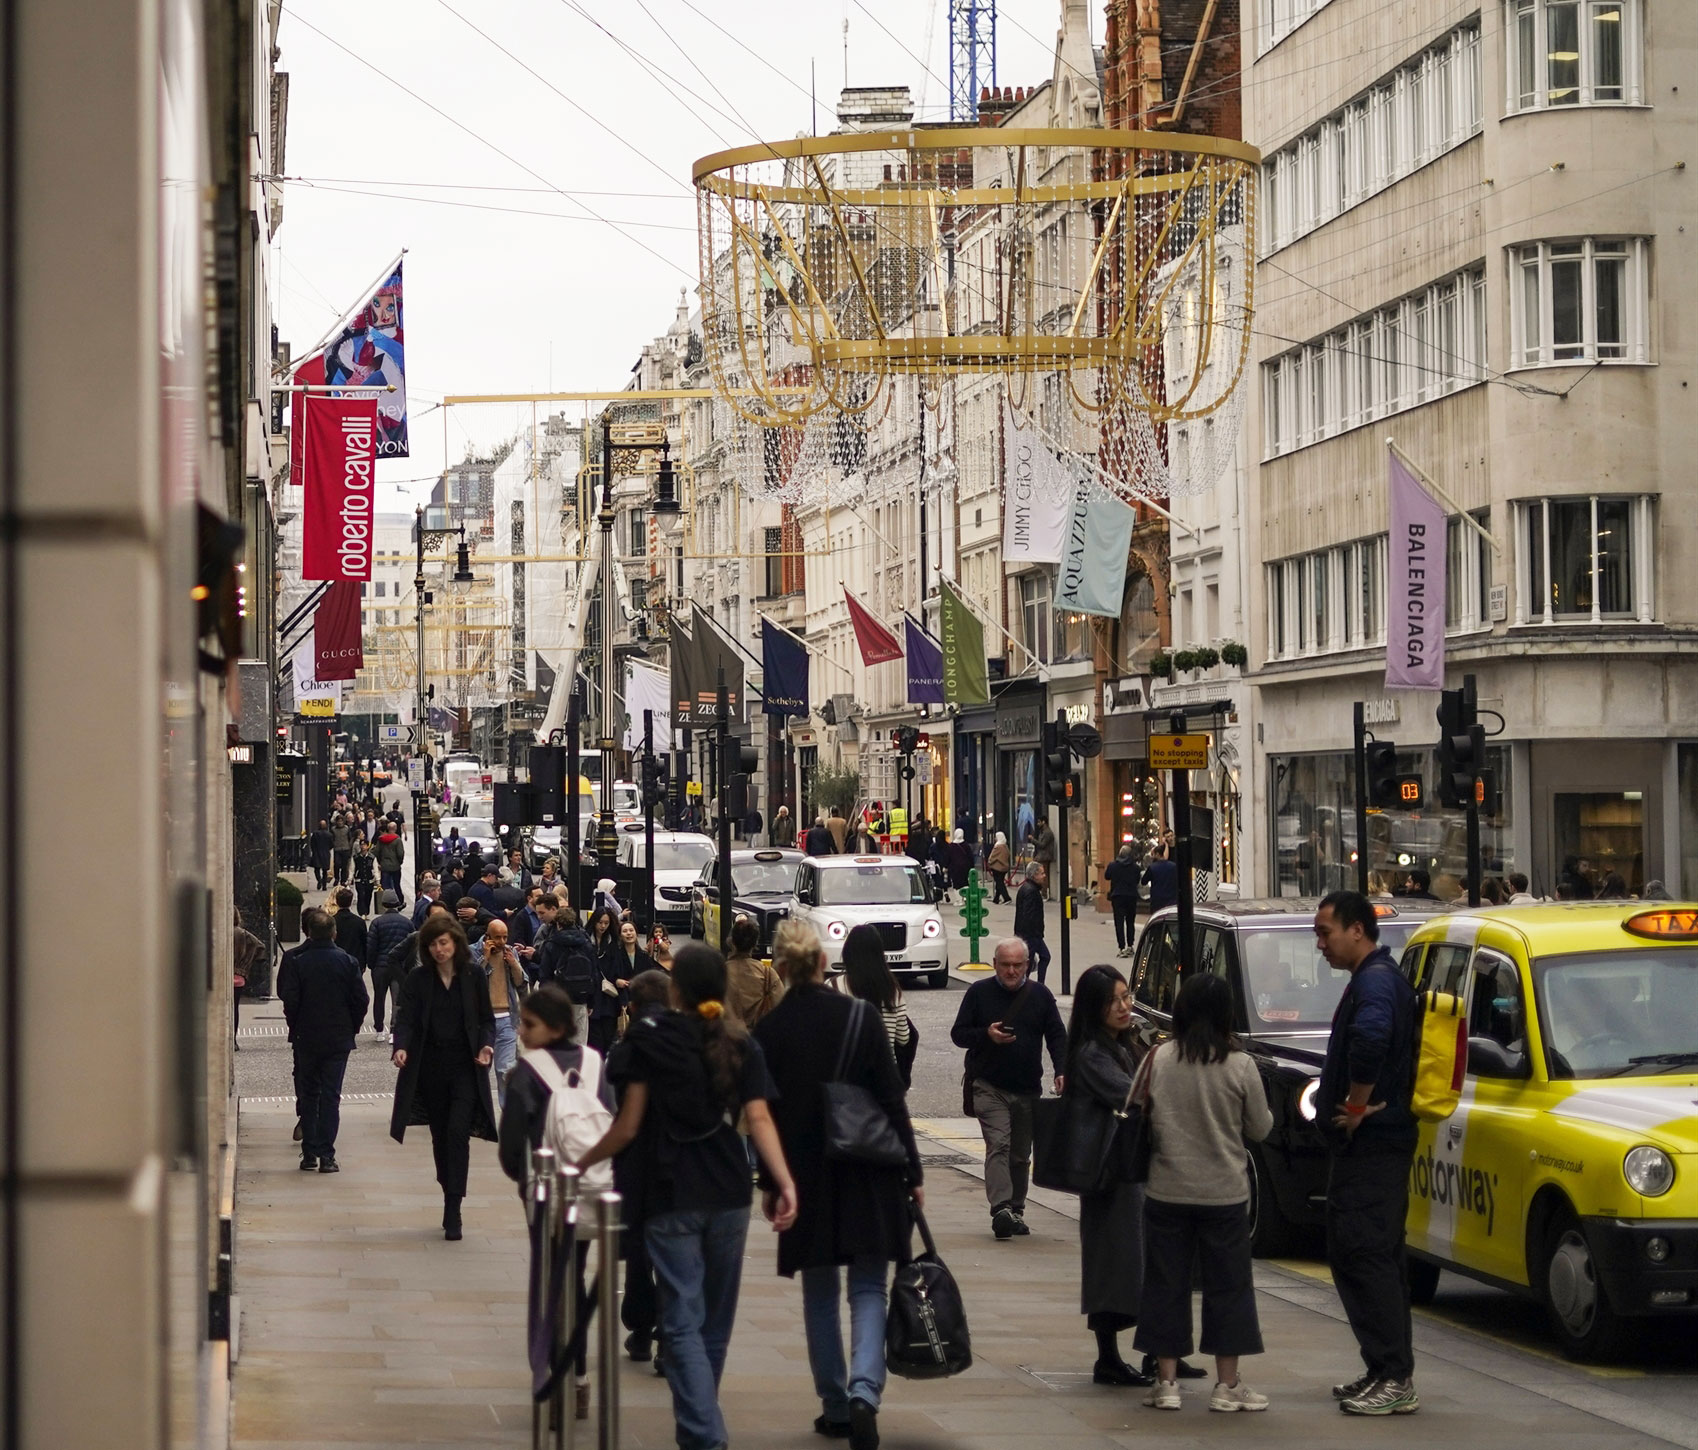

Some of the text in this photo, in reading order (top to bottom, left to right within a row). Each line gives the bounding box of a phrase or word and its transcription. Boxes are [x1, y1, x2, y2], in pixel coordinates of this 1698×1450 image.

[337, 416, 372, 577] roberto cavalli
[1014, 504, 1030, 551] JIMMY
[1406, 523, 1426, 669] BALENCIAGA
[321, 648, 360, 659] GUCCI
[944, 598, 957, 697] LONGCHAMP
[306, 699, 333, 708] FENDI
[697, 704, 736, 716] ZEGA
[1153, 749, 1204, 758] No stopping
[1153, 758, 1181, 766] except
[1401, 783, 1419, 799] 03
[1538, 1153, 1584, 1175] motorway.co.uk
